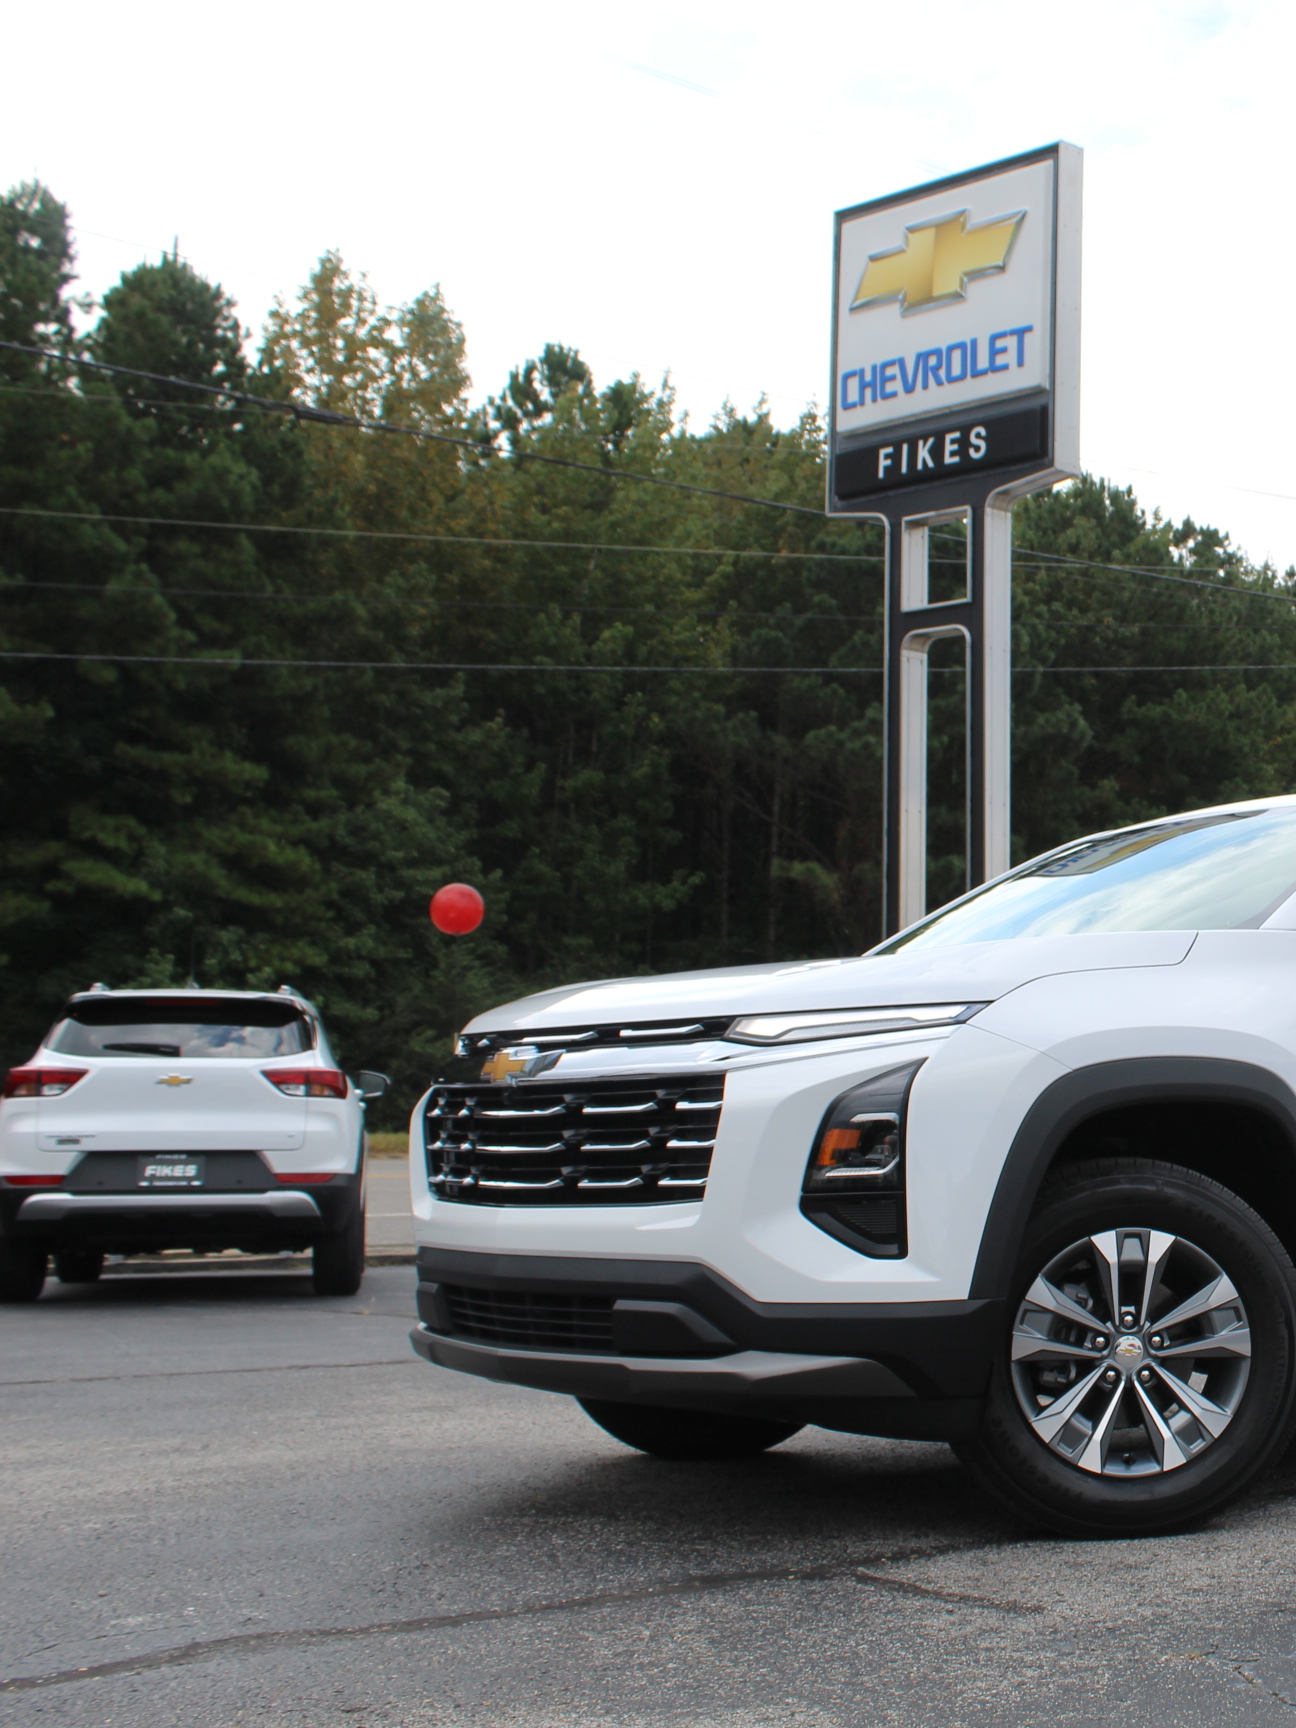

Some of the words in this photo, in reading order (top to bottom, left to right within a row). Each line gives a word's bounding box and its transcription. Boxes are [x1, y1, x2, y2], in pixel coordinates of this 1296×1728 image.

[840, 324, 1034, 411] CHEVROLET
[878, 425, 988, 479] FIKES
[143, 1164, 199, 1177] FIKES
